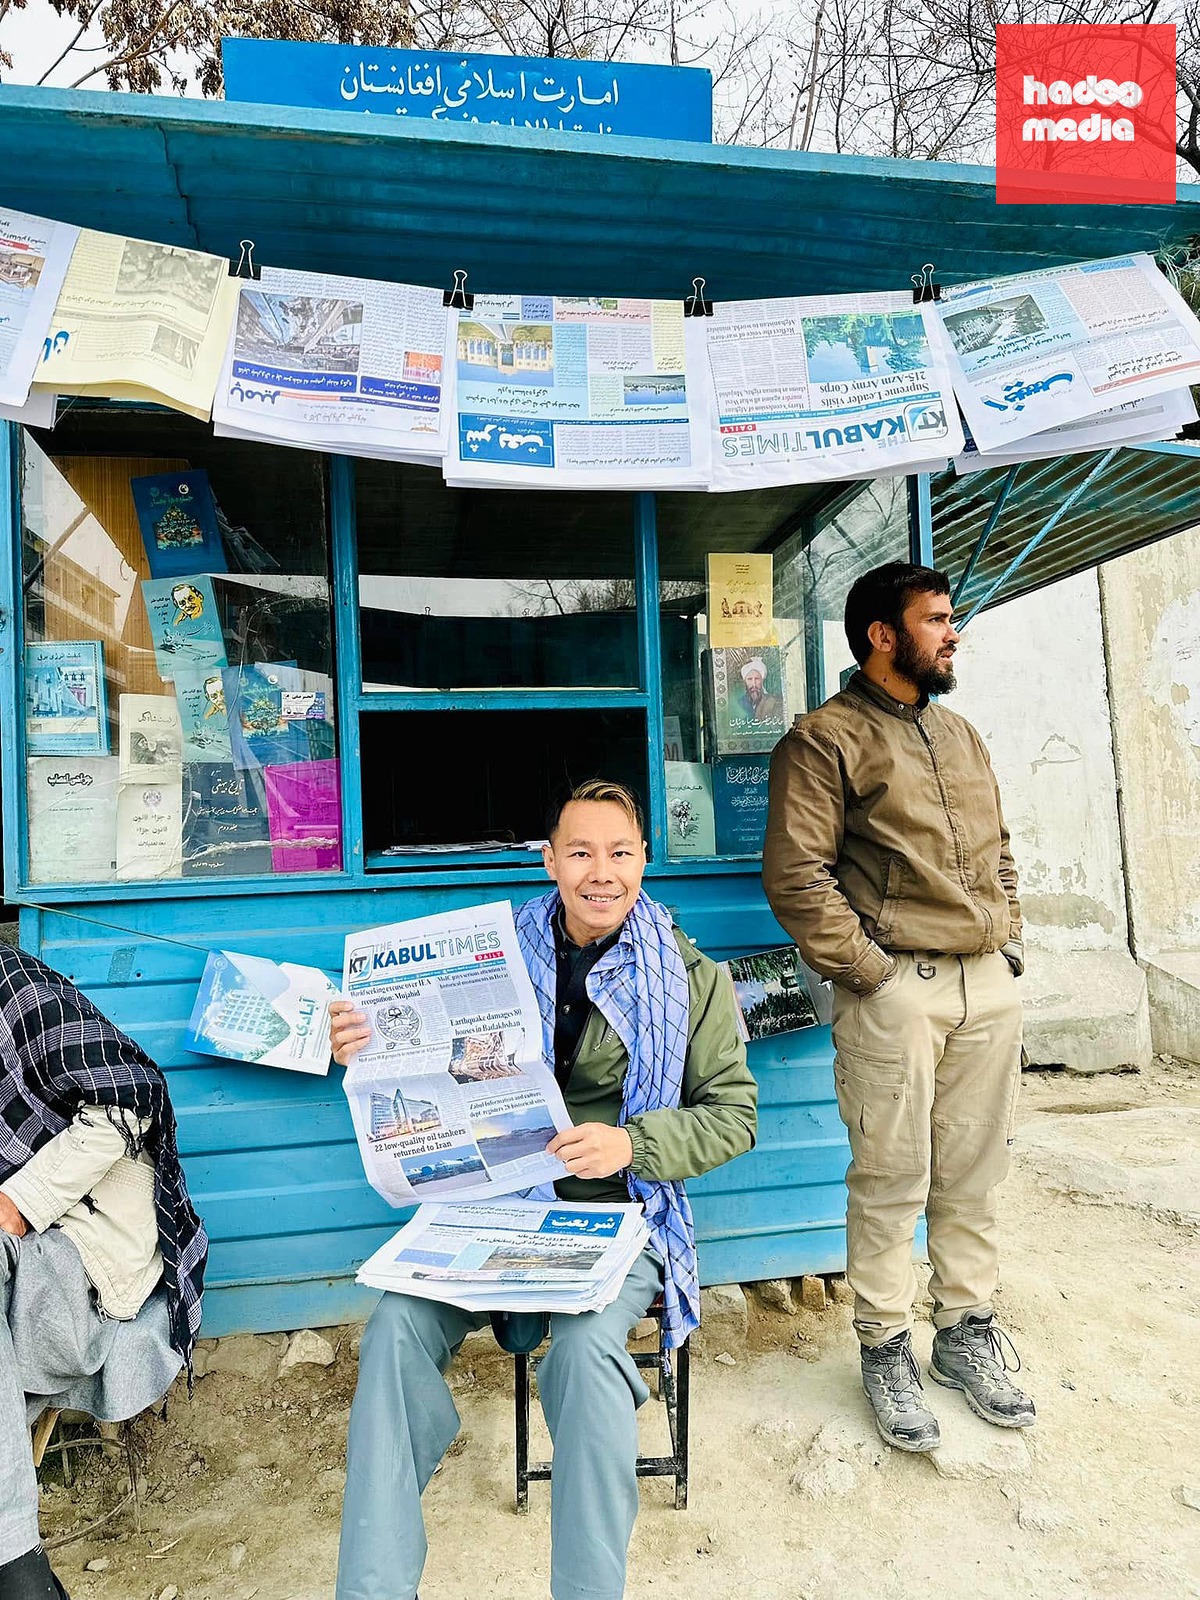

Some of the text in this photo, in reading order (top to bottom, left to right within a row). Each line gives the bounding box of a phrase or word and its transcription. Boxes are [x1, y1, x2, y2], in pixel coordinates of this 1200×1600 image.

[340, 61, 441, 100] افغانستان
[533, 75, 619, 113] امارت
[760, 319, 796, 329] Afghanistan
[819, 371, 926, 395] 215-Azm Army Corps
[230, 381, 280, 404] پامیر
[821, 382, 930, 408] Supreme Leader visits
[721, 424, 753, 433] DAILY
[722, 415, 906, 457] KABUL TIMES
[466, 424, 544, 455] شریعت
[877, 434, 908, 449] THE
[373, 931, 501, 970] KABUL TIMES
[374, 941, 392, 953] THE
[477, 951, 502, 960] DAILY
[394, 989, 421, 1000] Mujahid
[450, 1012, 486, 1027] Earthquake
[486, 1011, 514, 1021] damages
[455, 1027, 475, 1036] houses
[482, 1020, 521, 1032] Badakhshan
[374, 1128, 466, 1153] 22 low-quality oil tankers
[393, 1141, 453, 1159] returned to Iran
[551, 1215, 617, 1232] شریعت
